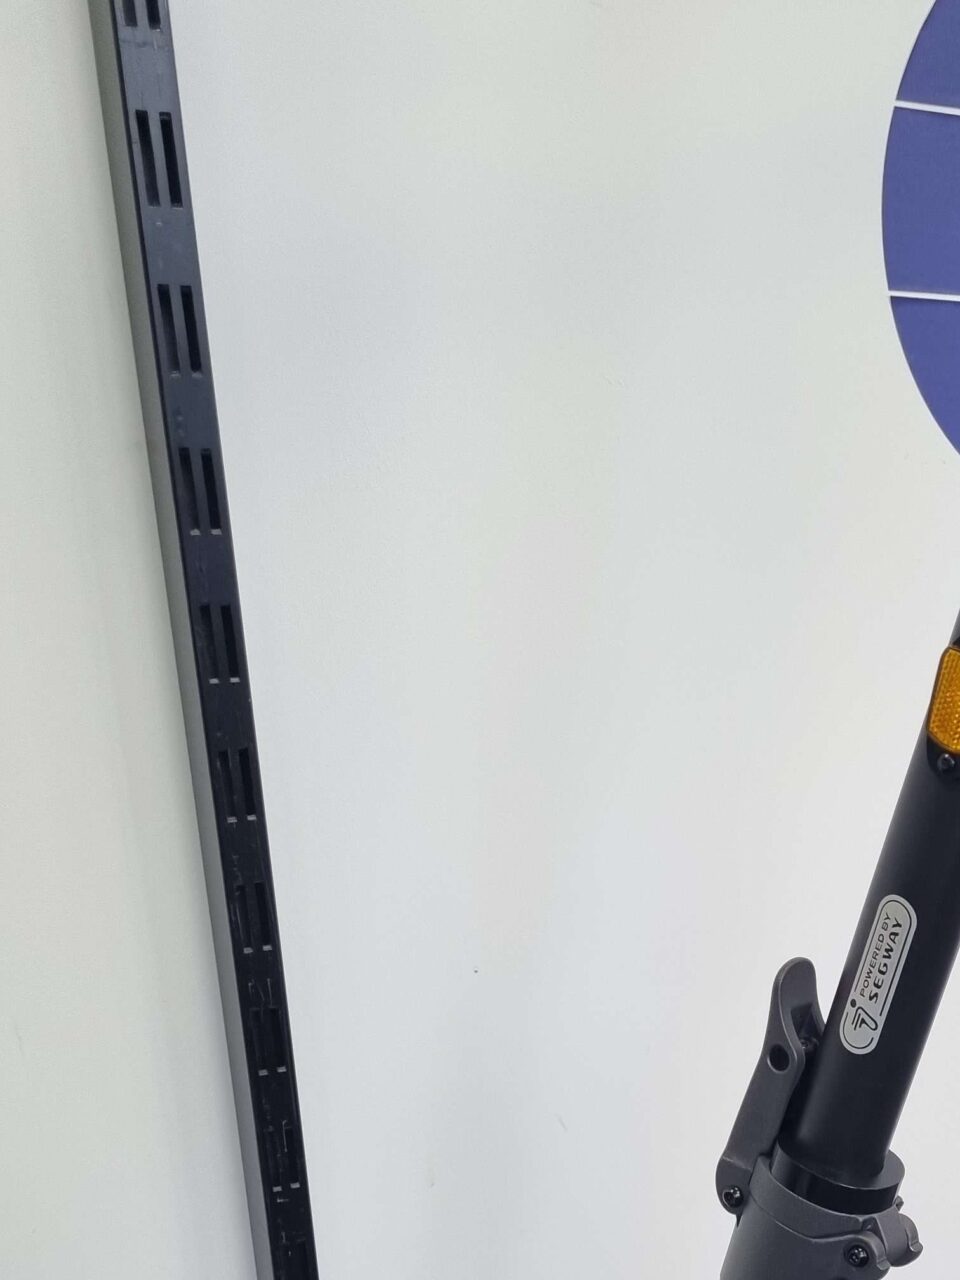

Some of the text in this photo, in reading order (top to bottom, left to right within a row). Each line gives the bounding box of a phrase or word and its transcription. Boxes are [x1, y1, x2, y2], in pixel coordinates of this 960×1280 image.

[860, 912, 892, 997] POWERED BY
[868, 917, 903, 1004] SEGWAY
